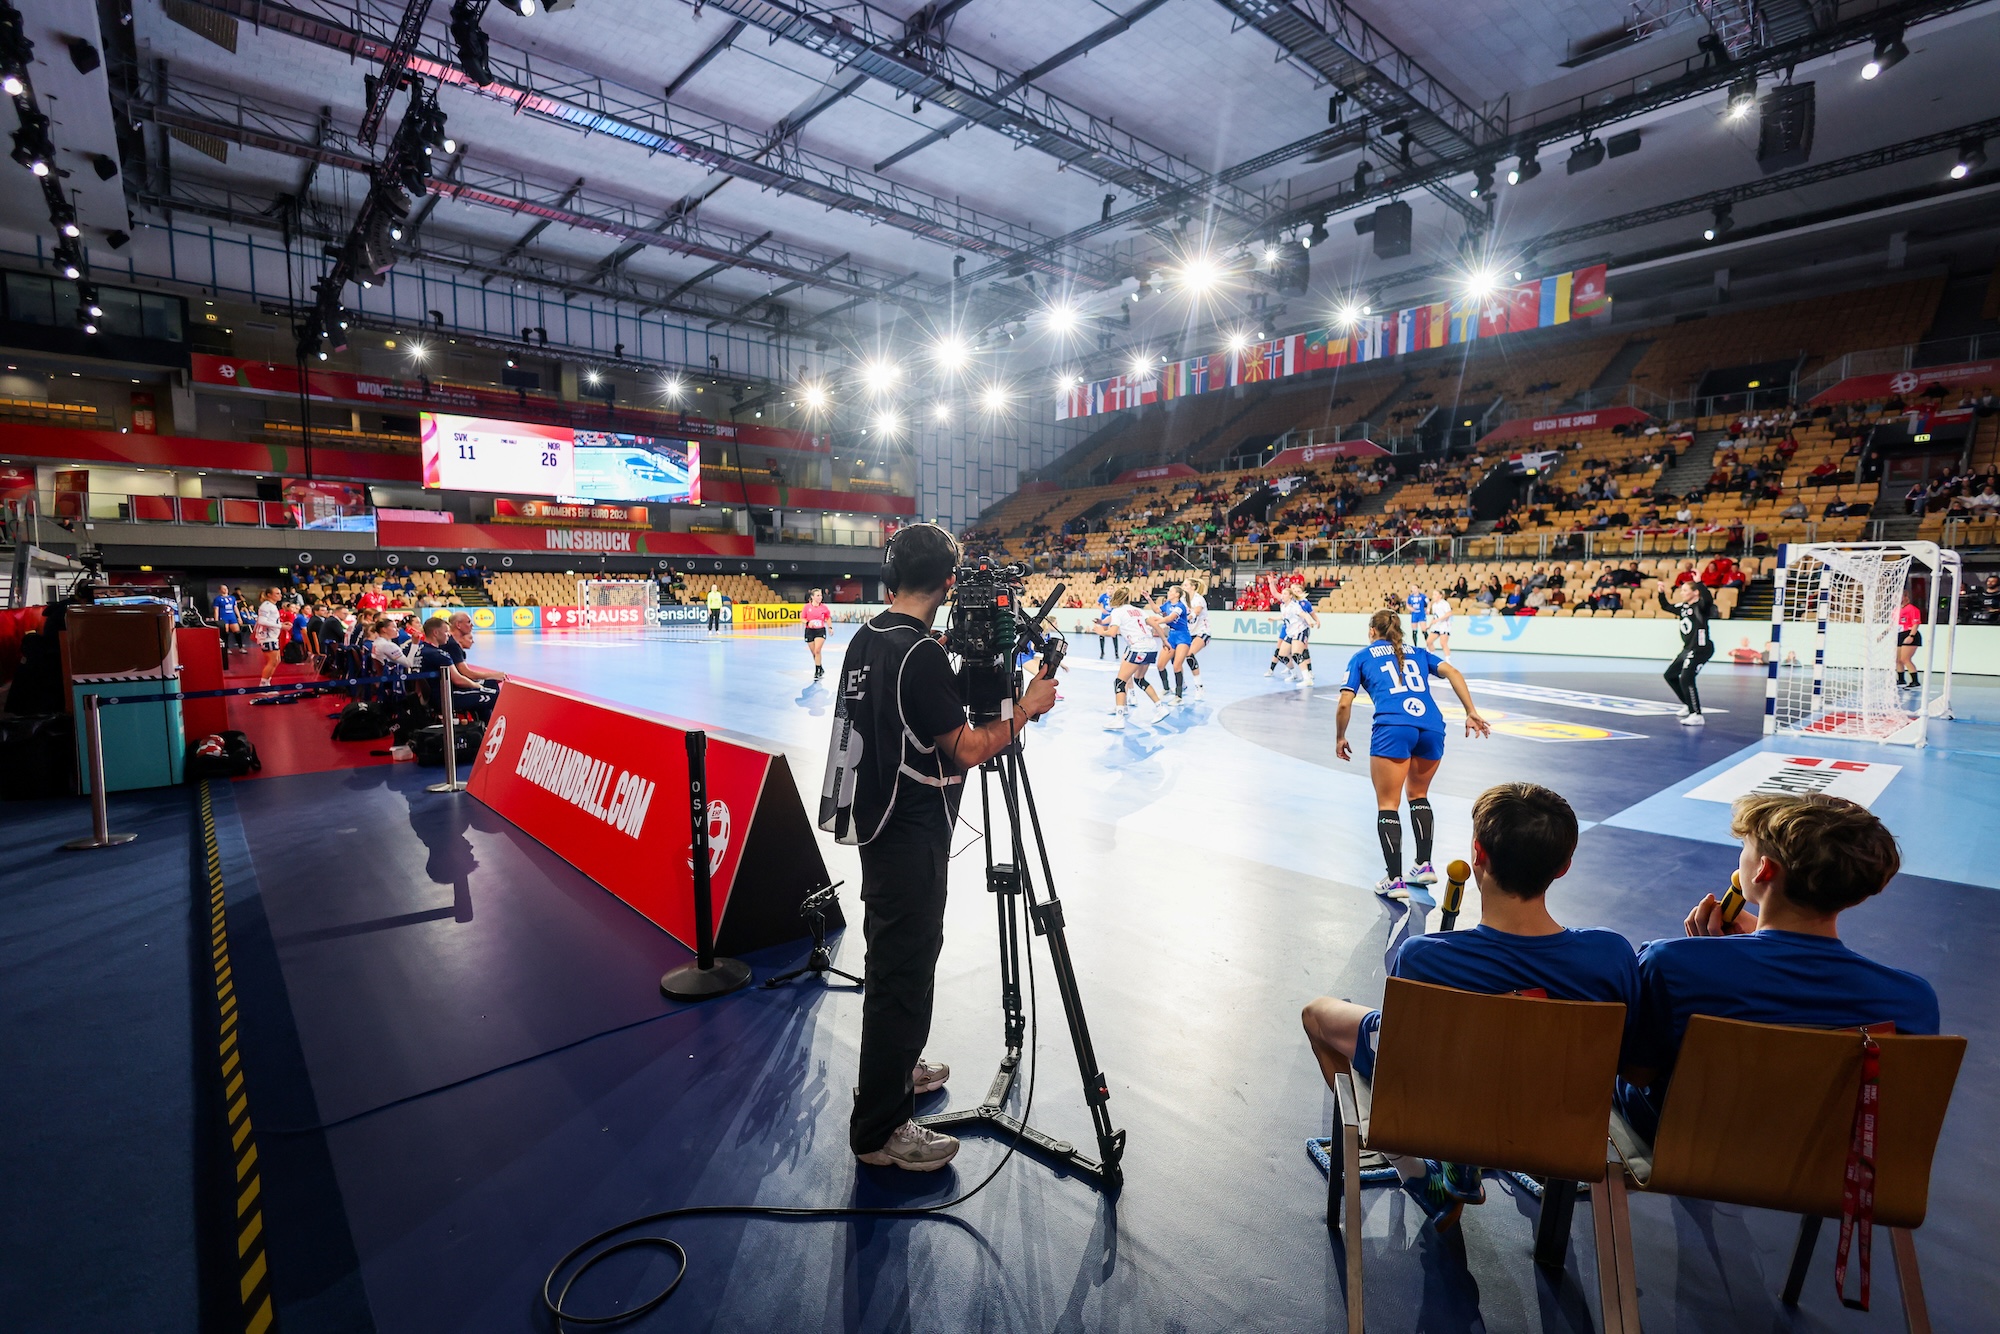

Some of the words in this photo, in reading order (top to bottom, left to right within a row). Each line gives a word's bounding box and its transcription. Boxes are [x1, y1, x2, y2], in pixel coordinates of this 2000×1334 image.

[1533, 419, 1557, 432] CATCH
[1558, 417, 1572, 429] THE
[1572, 414, 1598, 427] SPIRIT
[453, 432, 468, 442] SVK
[458, 444, 476, 460] 11
[547, 442, 561, 451] NOR
[541, 452, 557, 467] 26
[541, 505, 577, 518] WOMEN'S
[578, 507, 591, 518] EHF
[591, 508, 609, 519] EURO
[609, 509, 628, 520] 2024
[545, 529, 631, 551] INNSBRUCK
[566, 608, 639, 624] STRAUSS
[1380, 659, 1426, 695] 18
[515, 731, 656, 840] EUROHANDBALL.COM
